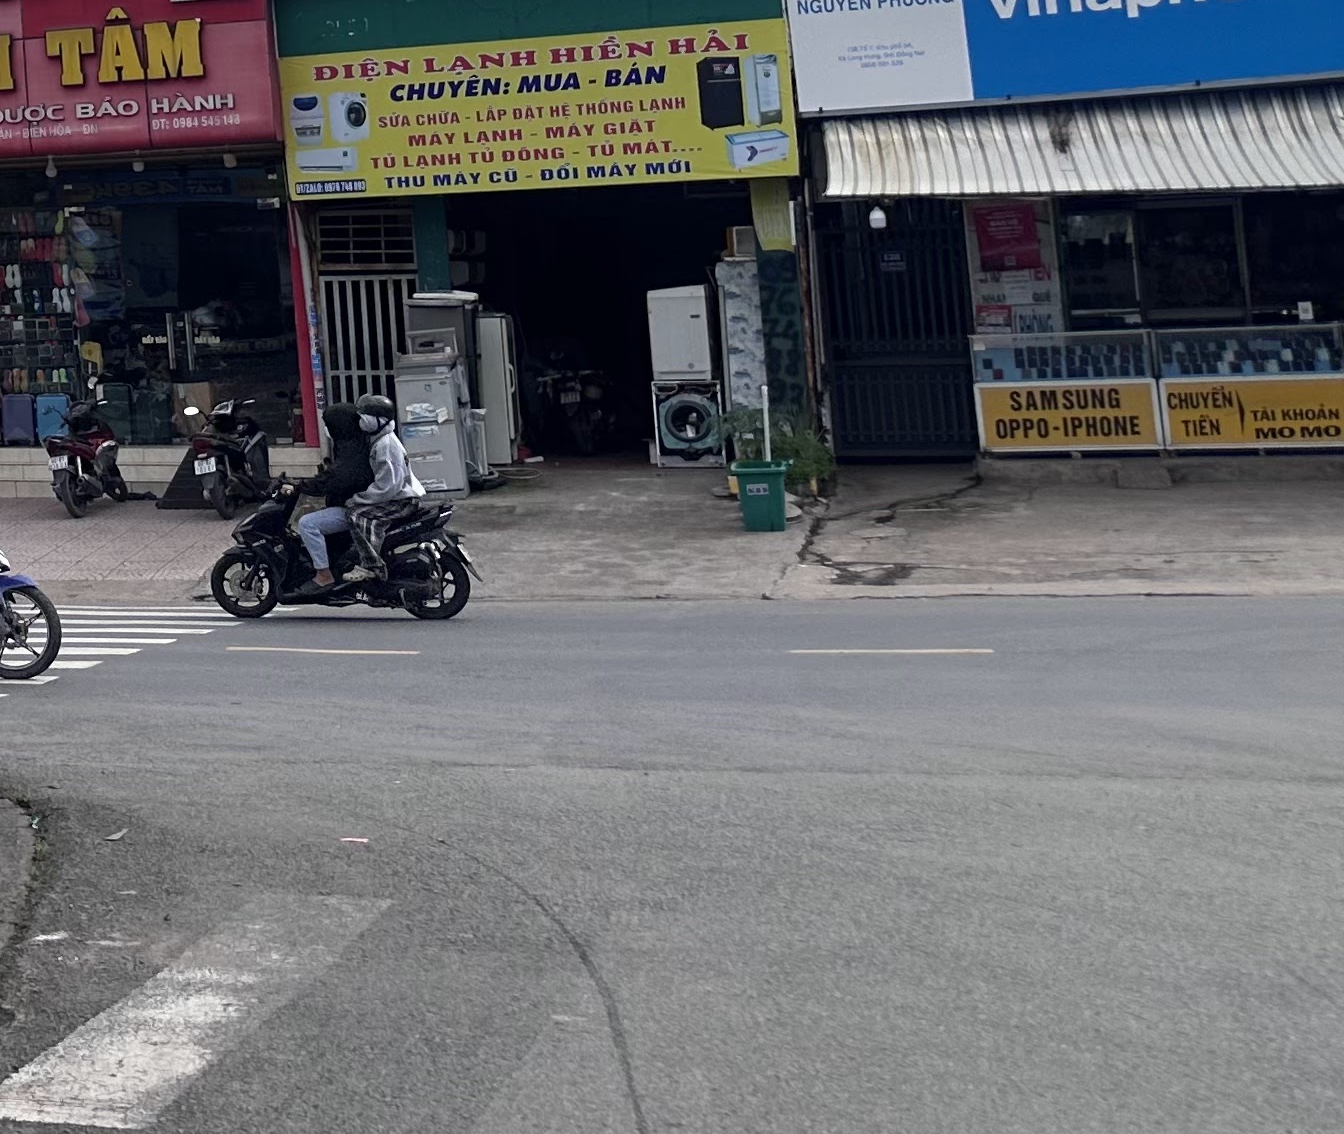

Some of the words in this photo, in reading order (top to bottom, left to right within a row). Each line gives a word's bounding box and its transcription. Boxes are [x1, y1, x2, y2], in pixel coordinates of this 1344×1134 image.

[45, 7, 204, 87] TÂM
[313, 58, 411, 82] ĐIỆN
[422, 48, 537, 76] LẠNH
[668, 29, 750, 55] HẢI
[389, 74, 511, 103] CHUYÊN:
[516, 71, 581, 94] MUA
[604, 62, 667, 88] BÁN
[75, 96, 140, 120] BẢO
[151, 92, 235, 114] HÀNH
[512, 103, 544, 123] ĐẶT
[549, 102, 572, 120] HỆ
[639, 96, 687, 115] LẠNH
[408, 130, 456, 148] MÁY
[463, 128, 524, 148] LẠNH
[544, 121, 596, 140] MÁY
[603, 117, 656, 137] GIẶT
[384, 175, 426, 189] THU
[432, 170, 482, 187] MÁY
[488, 167, 518, 184] CŨ
[586, 161, 638, 179] MÁY
[645, 158, 692, 175] MỚI
[403, 150, 462, 170] LẠNH
[1010, 387, 1121, 412] SAMSUNG
[1166, 385, 1234, 410] CHUYỂN
[1250, 407, 1277, 422] TÀI
[1282, 402, 1341, 422] KHOẢN
[995, 415, 1141, 439] OPPO-IPHONE
[1254, 425, 1291, 439] MO
[1293, 423, 1342, 438] MO
